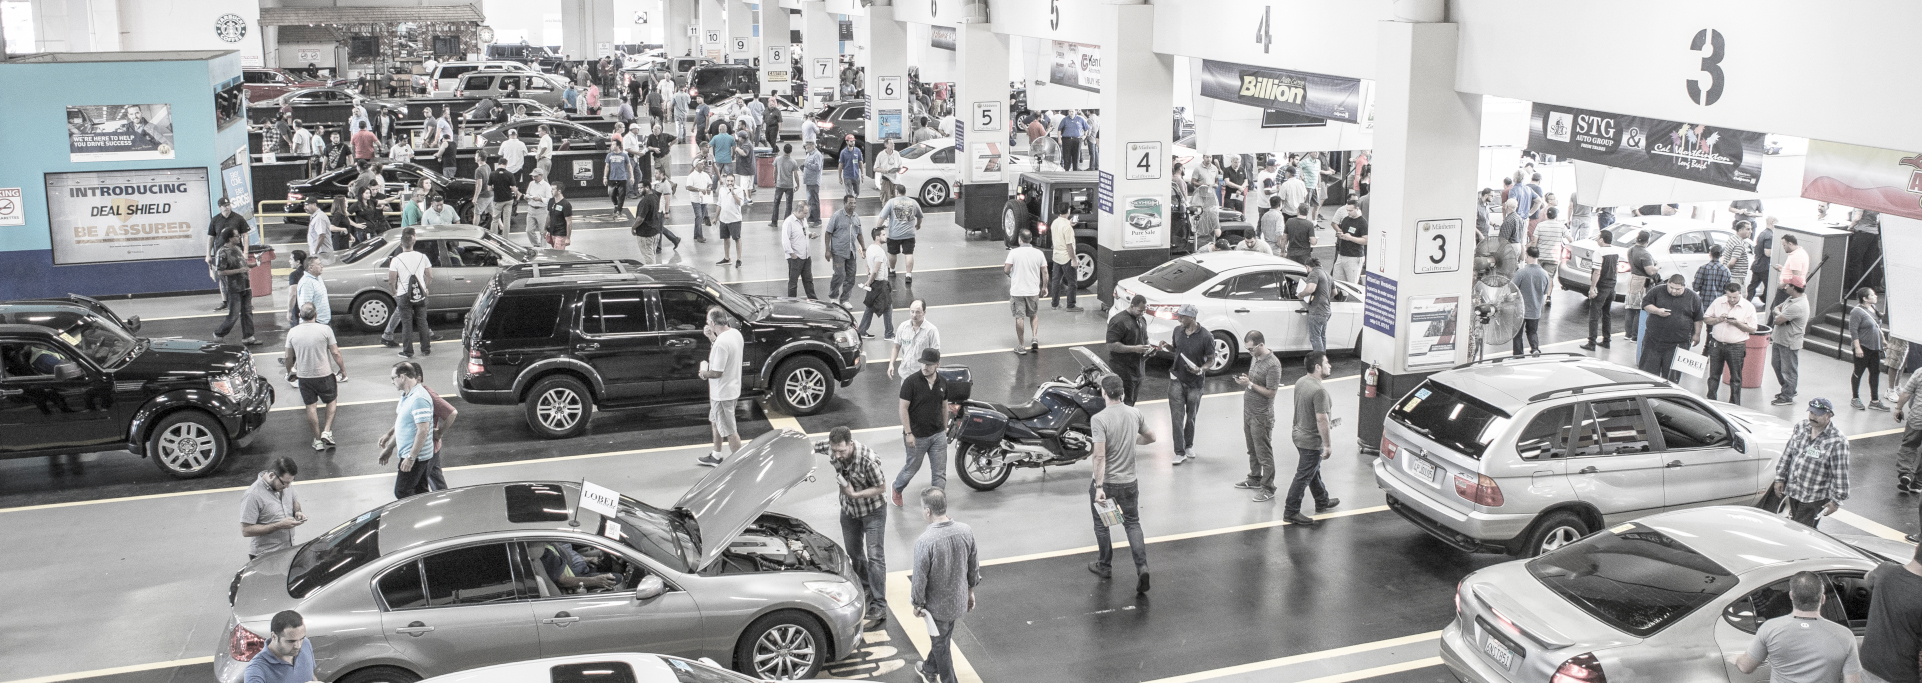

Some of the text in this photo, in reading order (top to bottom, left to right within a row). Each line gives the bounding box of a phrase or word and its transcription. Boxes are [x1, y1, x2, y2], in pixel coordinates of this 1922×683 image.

[1256, 6, 1272, 54] 4
[708, 34, 718, 42] 10
[738, 40, 744, 50] 9
[774, 50, 780, 60] 8
[820, 64, 827, 75] 7
[1686, 28, 1725, 106] 3
[885, 82, 894, 96] 6
[1240, 76, 1304, 104] Billion
[982, 110, 992, 125] 5
[1576, 114, 1616, 138] STG
[1592, 137, 1614, 146] GROUP
[1626, 127, 1642, 149] &
[1654, 144, 1730, 162] Cal Worthington
[1137, 152, 1150, 172] 4
[1678, 158, 1707, 170] Long Beach
[70, 183, 188, 198] INTRODUCING
[91, 203, 171, 217] DEAL SHIELD
[74, 222, 191, 238] BE ASSURED
[1429, 234, 1446, 264] 3
[1678, 356, 1704, 369] LOBEL
[584, 490, 616, 507] LOBEL
